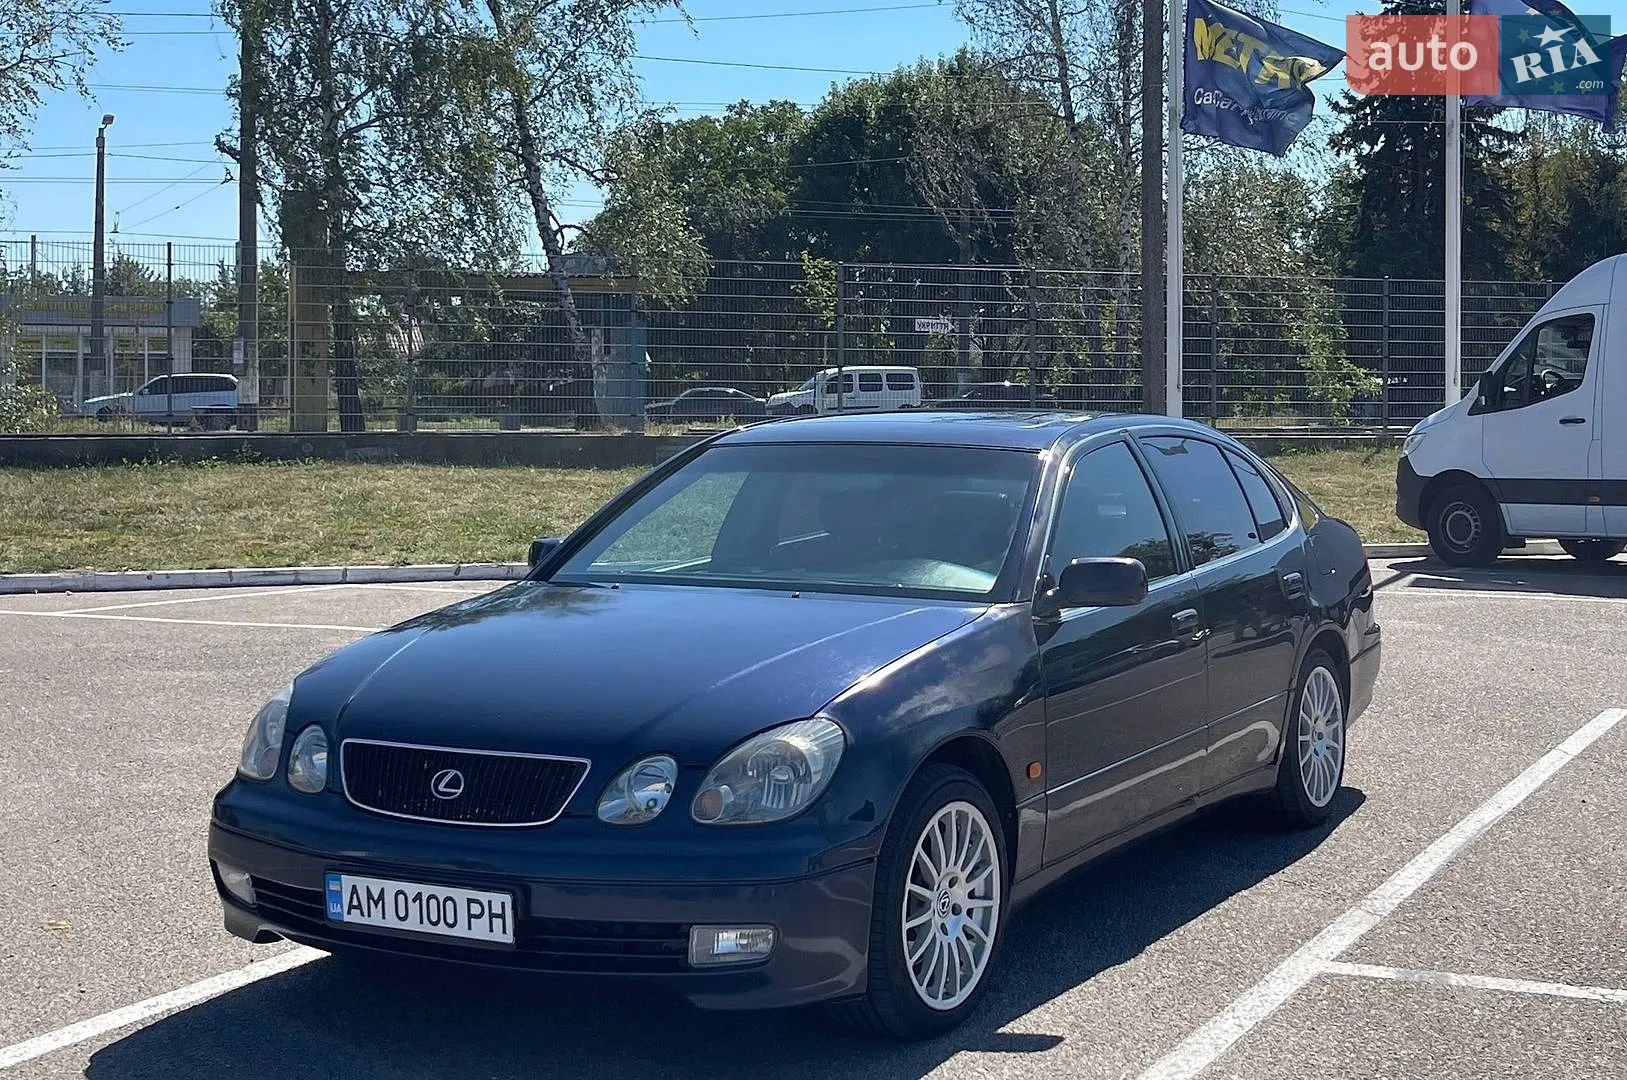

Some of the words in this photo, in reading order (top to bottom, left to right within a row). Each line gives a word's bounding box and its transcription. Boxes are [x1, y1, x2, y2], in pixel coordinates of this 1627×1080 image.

[330, 902, 342, 914] UA
[347, 884, 386, 920] AM
[394, 889, 458, 929] 0100
[466, 897, 507, 935] PH
